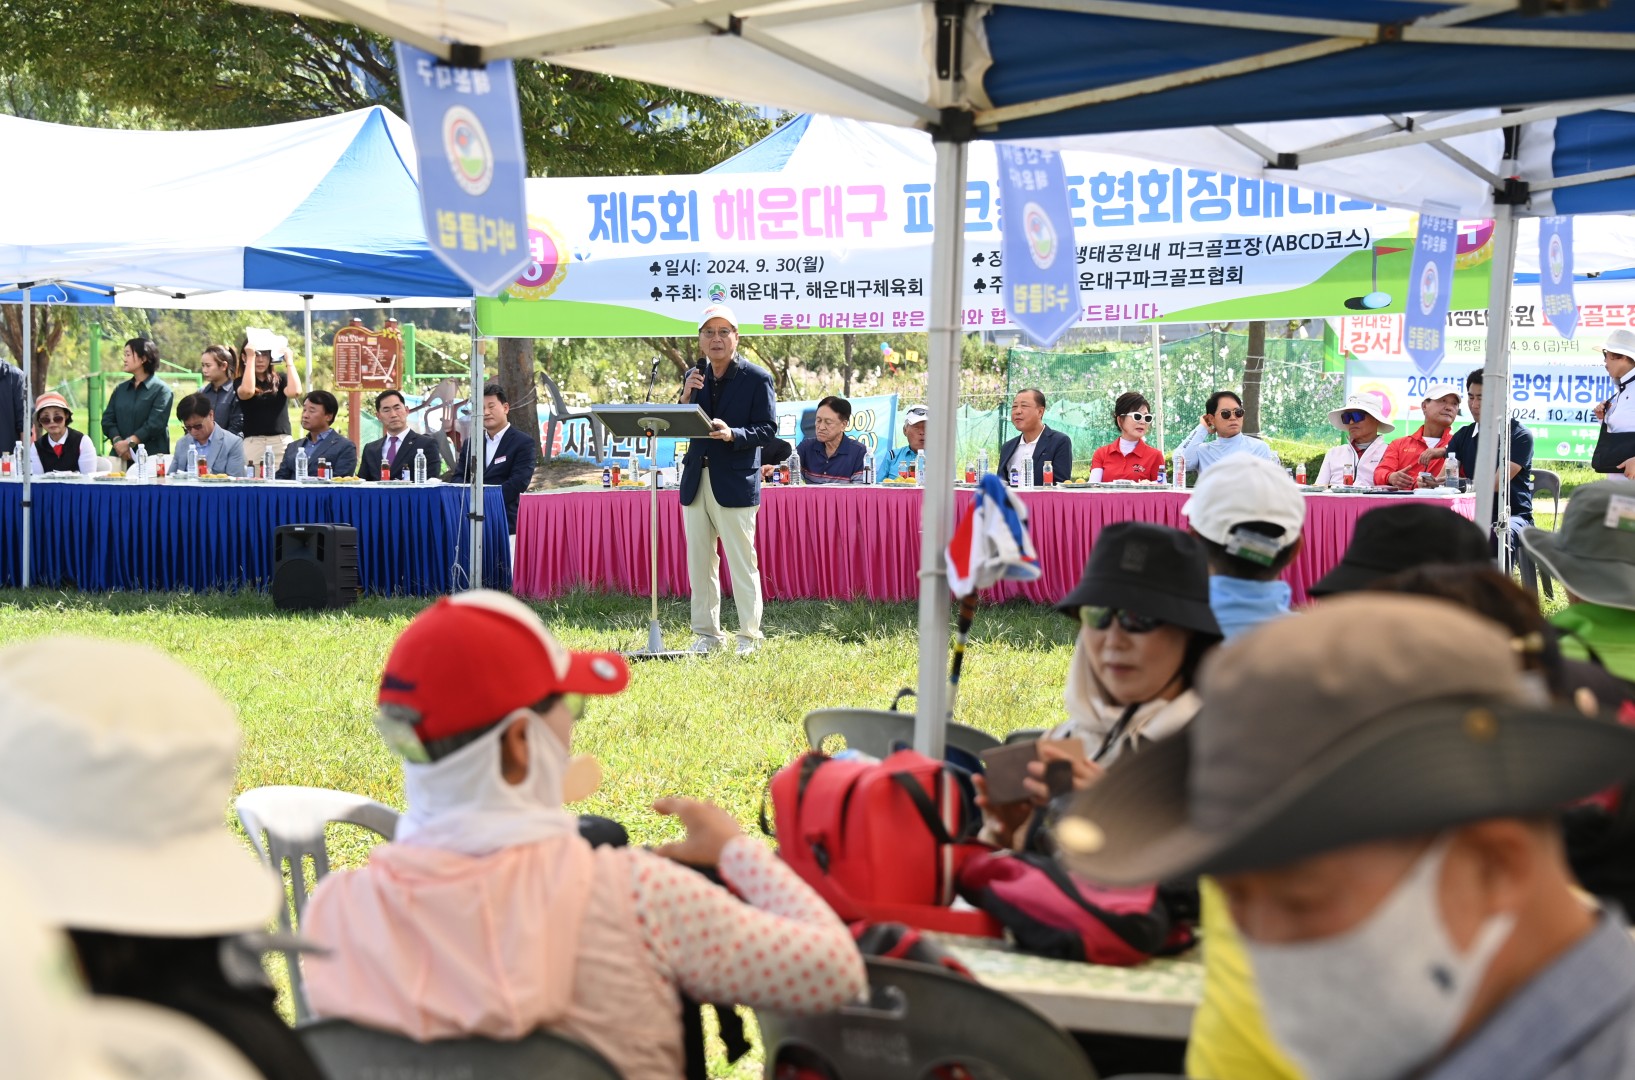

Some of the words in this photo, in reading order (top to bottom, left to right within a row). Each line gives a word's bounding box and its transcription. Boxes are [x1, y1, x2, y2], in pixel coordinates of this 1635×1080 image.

[587, 189, 700, 244] 제5회
[712, 185, 888, 241] 해운대구
[1075, 243, 1161, 264] 생태공원내
[665, 259, 701, 276] 일시:
[707, 259, 749, 274] 2024.
[756, 259, 770, 273] 9.
[775, 256, 825, 274] 30(월)
[1078, 265, 1244, 291] 운대구파크골프협회
[665, 284, 701, 302] 주최:
[730, 282, 800, 301] 해운대구,
[806, 278, 924, 299] 해운대구체육회
[763, 313, 811, 331] 동호인
[819, 311, 884, 329] 여러분의
[892, 310, 925, 328] 많은
[1078, 303, 1164, 323] 드립니다.
[1351, 331, 1392, 355] 강서
[1454, 339, 1481, 352] 개장일
[1512, 373, 1616, 404] 광역시장배
